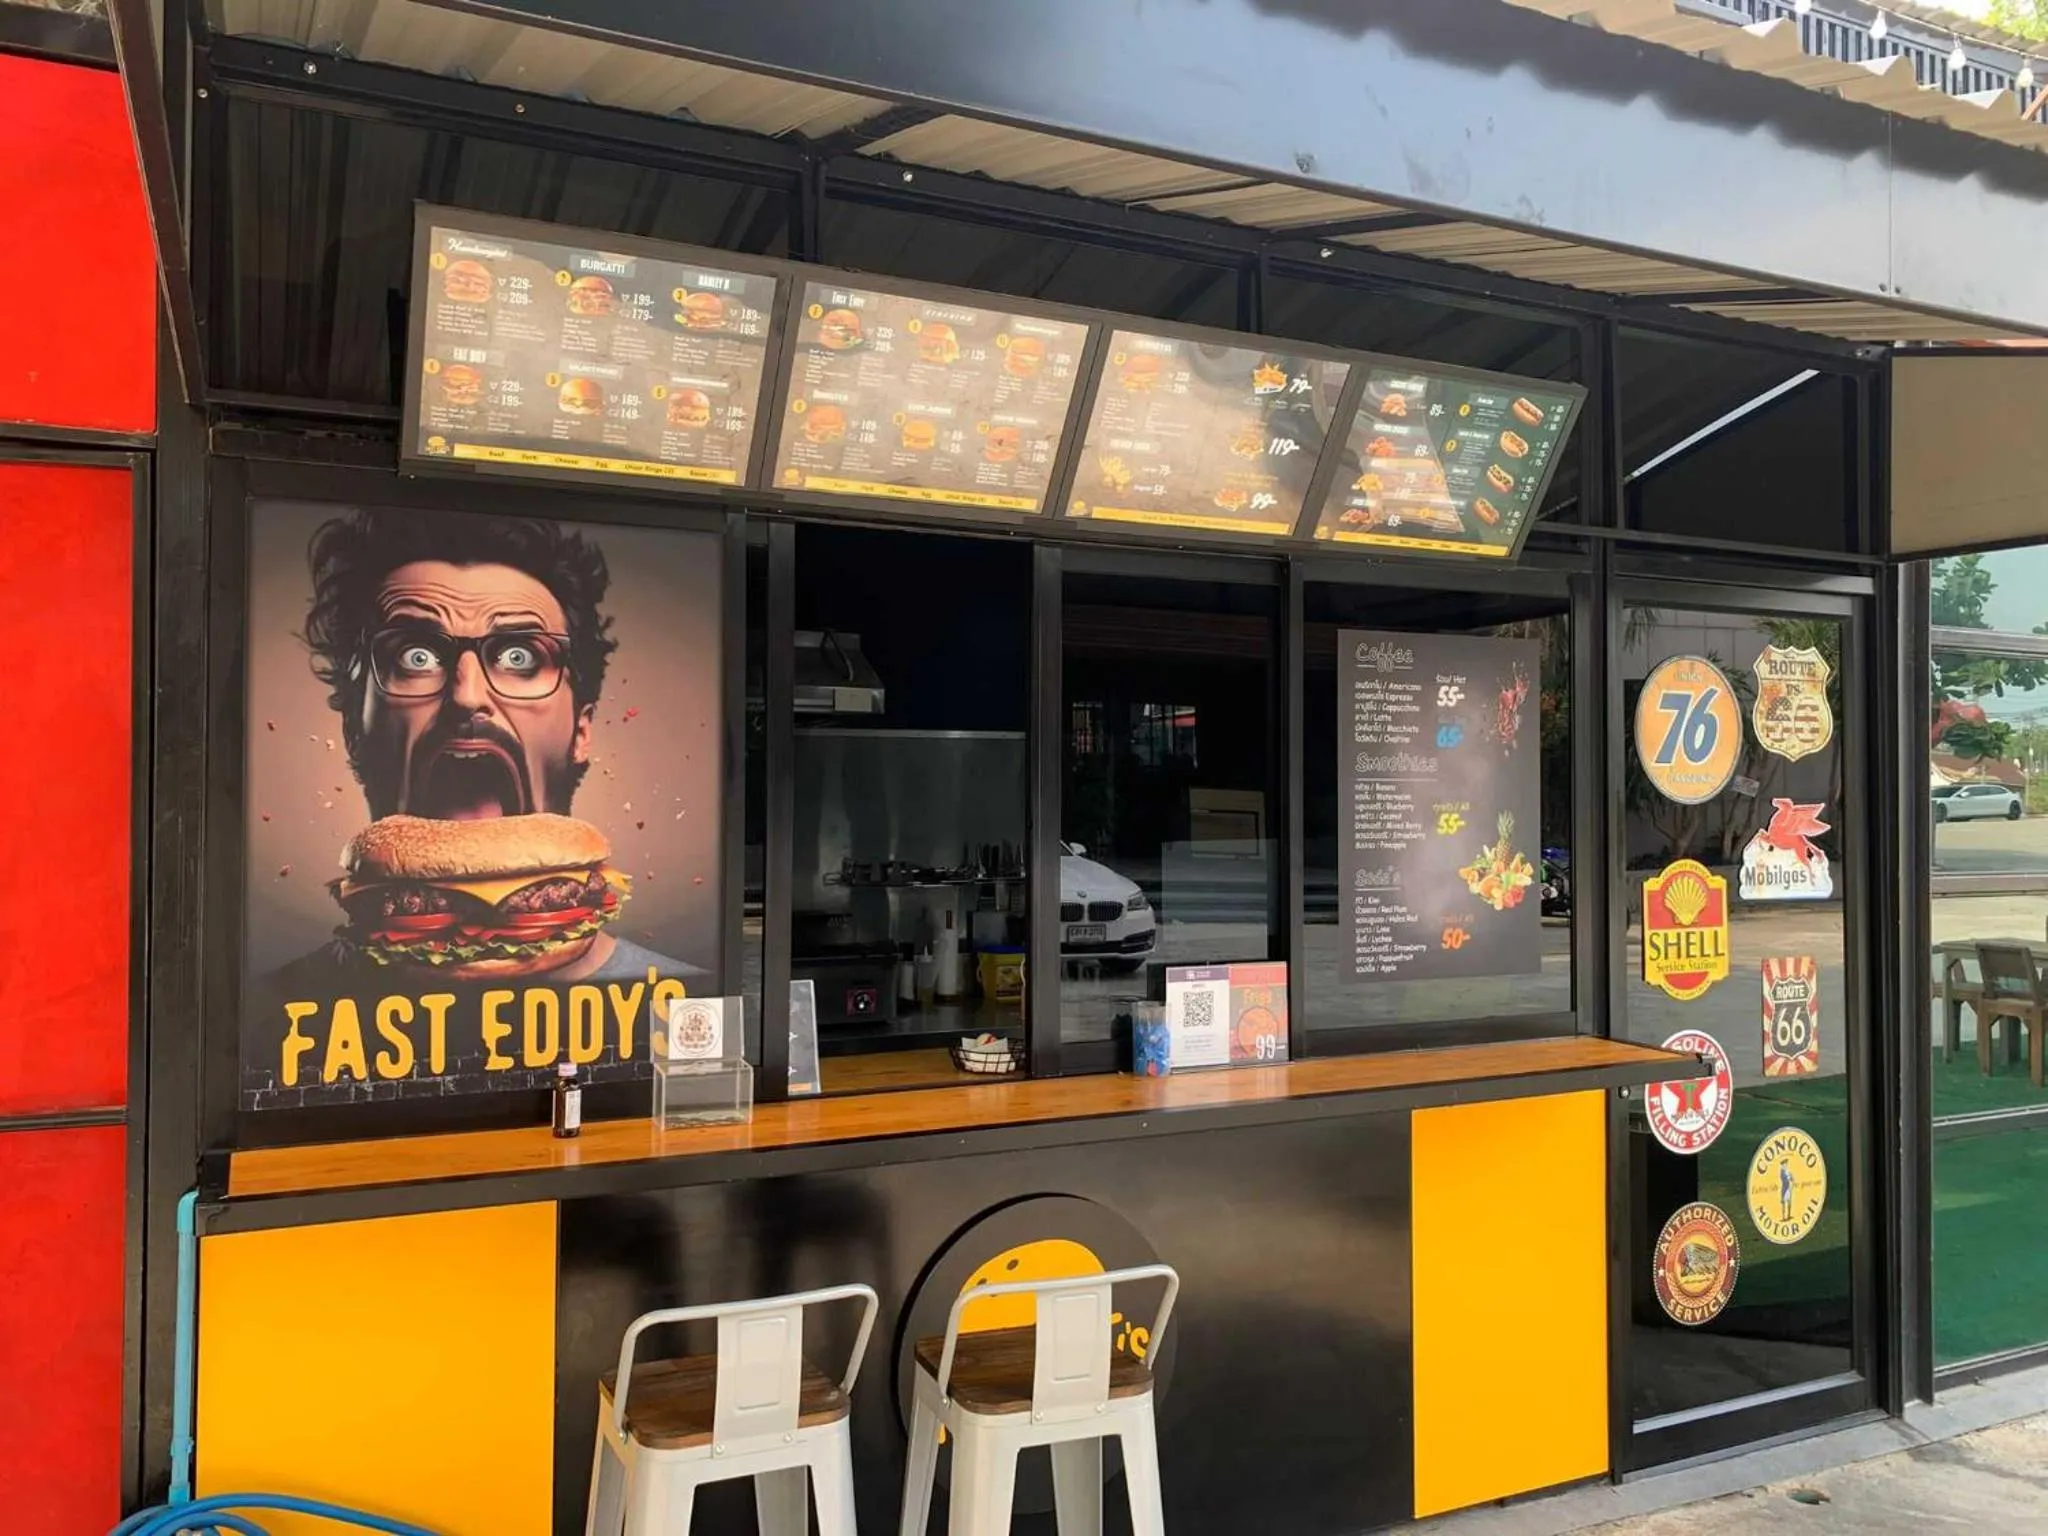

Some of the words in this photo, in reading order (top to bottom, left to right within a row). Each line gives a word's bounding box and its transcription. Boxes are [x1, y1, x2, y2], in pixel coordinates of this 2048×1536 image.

[1289, 378, 1313, 394] 79-
[1268, 437, 1300, 456] 119-
[1249, 492, 1278, 510] 99-
[1354, 642, 1414, 673] Coffee
[1769, 659, 1816, 678] ROUTE
[1436, 685, 1465, 707] 55-
[1652, 686, 1721, 767] 76
[1354, 752, 1438, 773] Smoothies
[1437, 812, 1465, 835] 55-
[1744, 864, 1808, 890] Mobilgas
[1441, 928, 1471, 950] 50-
[1649, 930, 1726, 962] SHELL
[1656, 961, 1687, 974] Service
[1775, 983, 1806, 999] ROUTE
[282, 992, 456, 1087] FAST
[481, 966, 687, 1072] EDDY'S
[1776, 1006, 1807, 1047] 66
[1649, 1096, 1687, 1147] FILLING
[1692, 1087, 1729, 1146] STATION
[1756, 1135, 1818, 1176] CONOCO
[1660, 1207, 1735, 1254] AUTHORIZED
[1757, 1205, 1800, 1238] MOTOR
[1802, 1197, 1820, 1226] OIL
[1667, 1290, 1728, 1321] SERVICE
